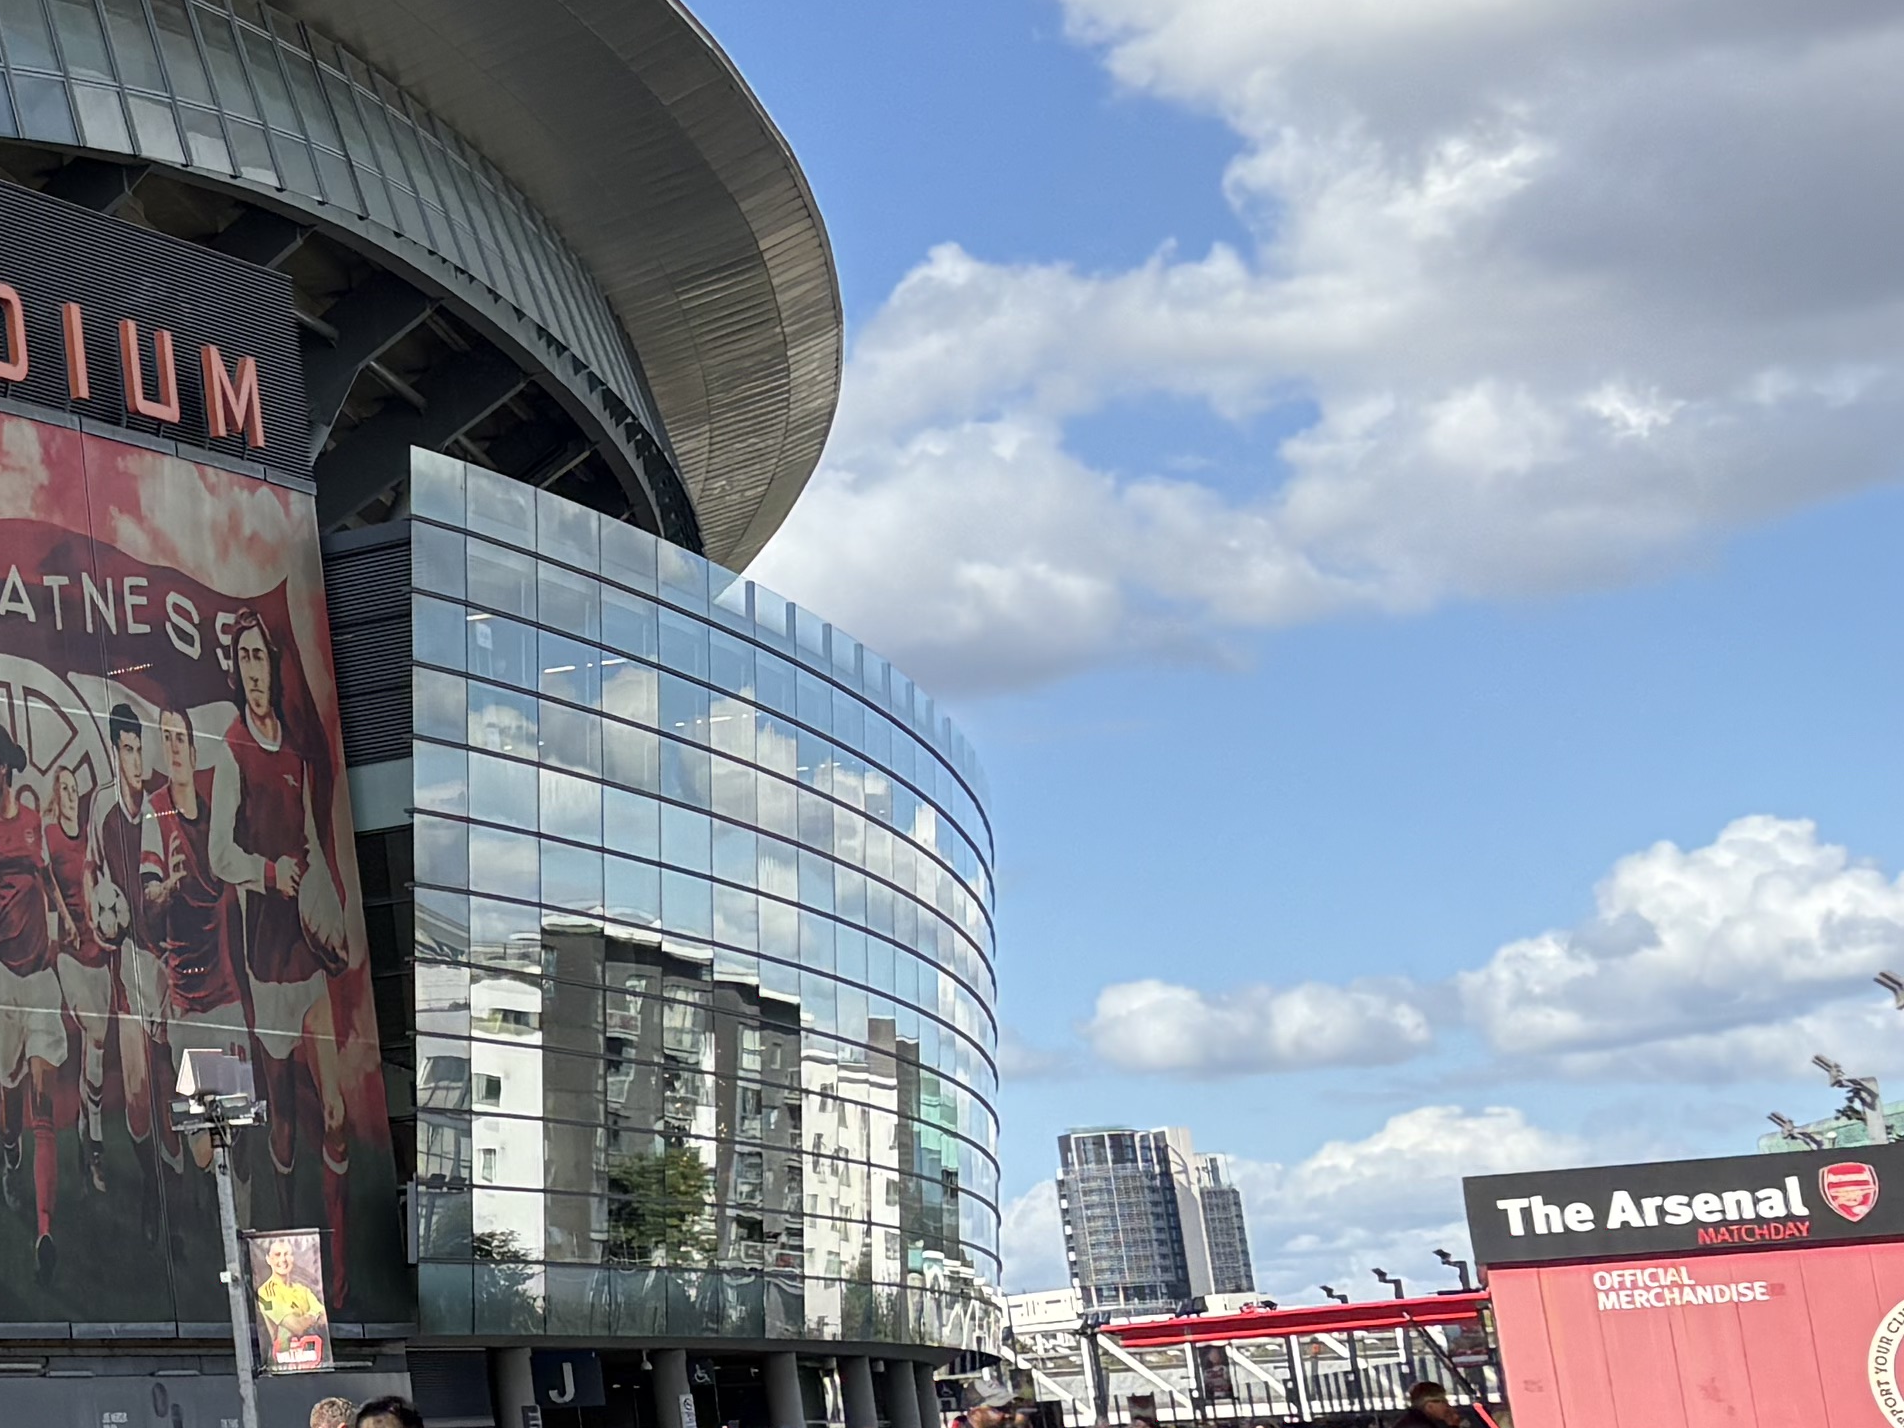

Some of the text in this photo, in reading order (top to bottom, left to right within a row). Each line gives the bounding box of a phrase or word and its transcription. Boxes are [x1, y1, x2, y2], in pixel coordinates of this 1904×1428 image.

[1497, 1176, 1810, 1236] The Arsenal
[1697, 1221, 1810, 1246] MATCHDAY
[1593, 1266, 1696, 1291] OFFICIAL
[1597, 1281, 1770, 1311] MERCHANDISE
[548, 1362, 575, 1404] J
